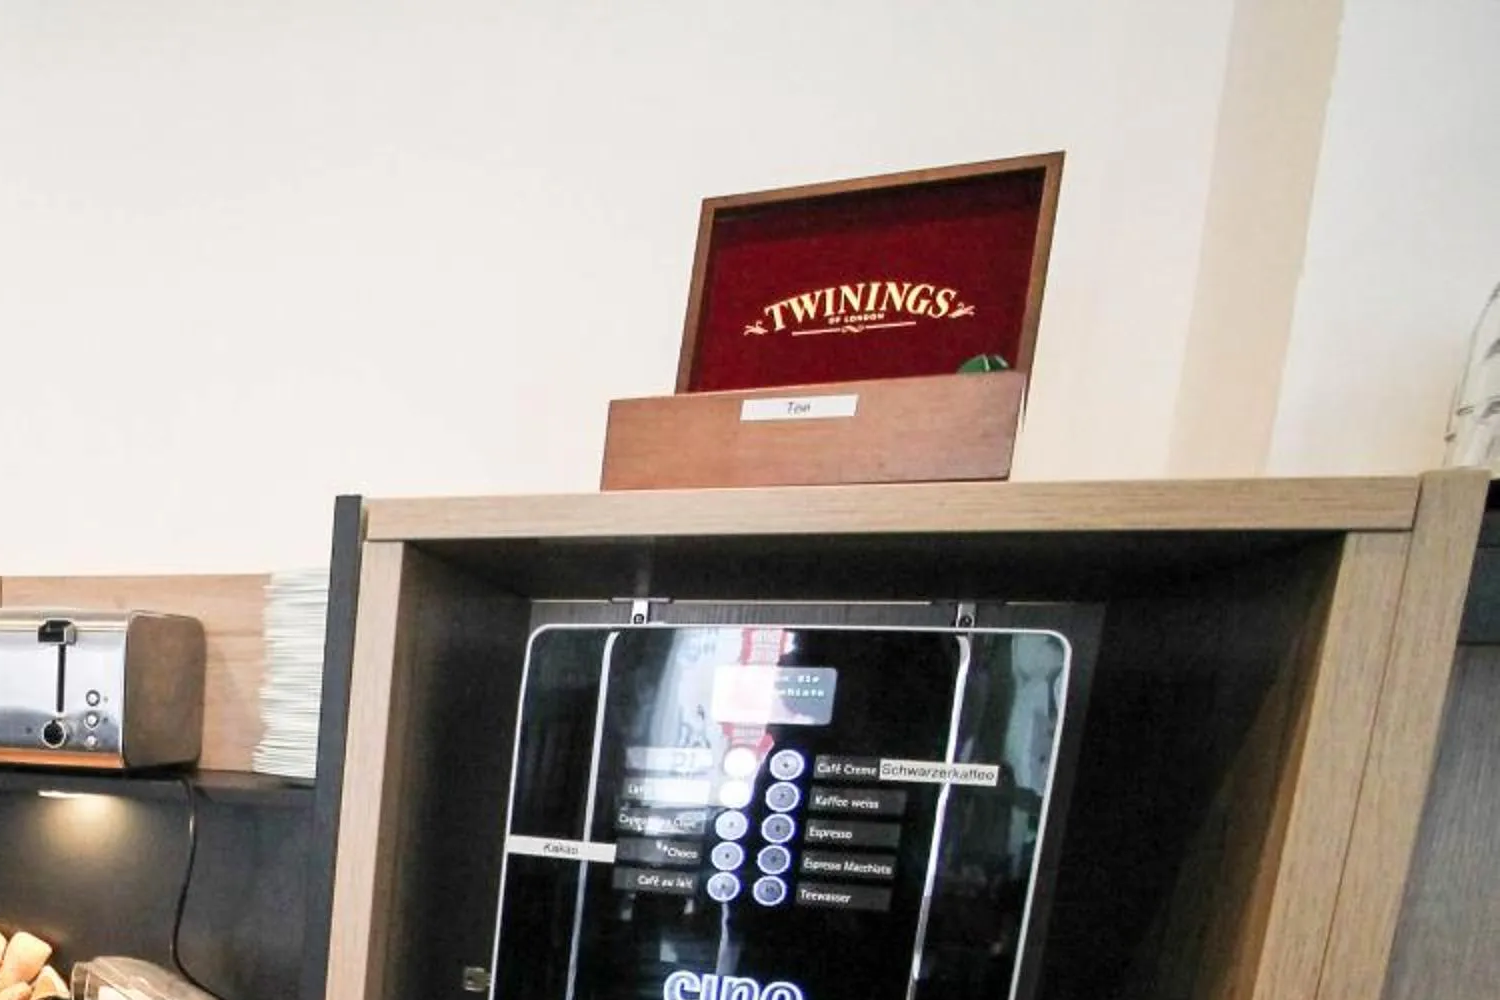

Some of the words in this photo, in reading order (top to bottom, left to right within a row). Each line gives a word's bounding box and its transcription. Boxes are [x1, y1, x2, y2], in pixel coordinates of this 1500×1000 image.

[764, 281, 957, 331] TWININGS
[828, 317, 841, 325] OF
[843, 313, 885, 323] LONDON
[817, 762, 842, 774] Café
[814, 795, 848, 807] Kaffee
[851, 799, 880, 809] weiss
[808, 826, 853, 840] Espresso
[803, 858, 843, 872] Espresso
[637, 874, 659, 887] Café
[800, 888, 852, 904] Teewasser
